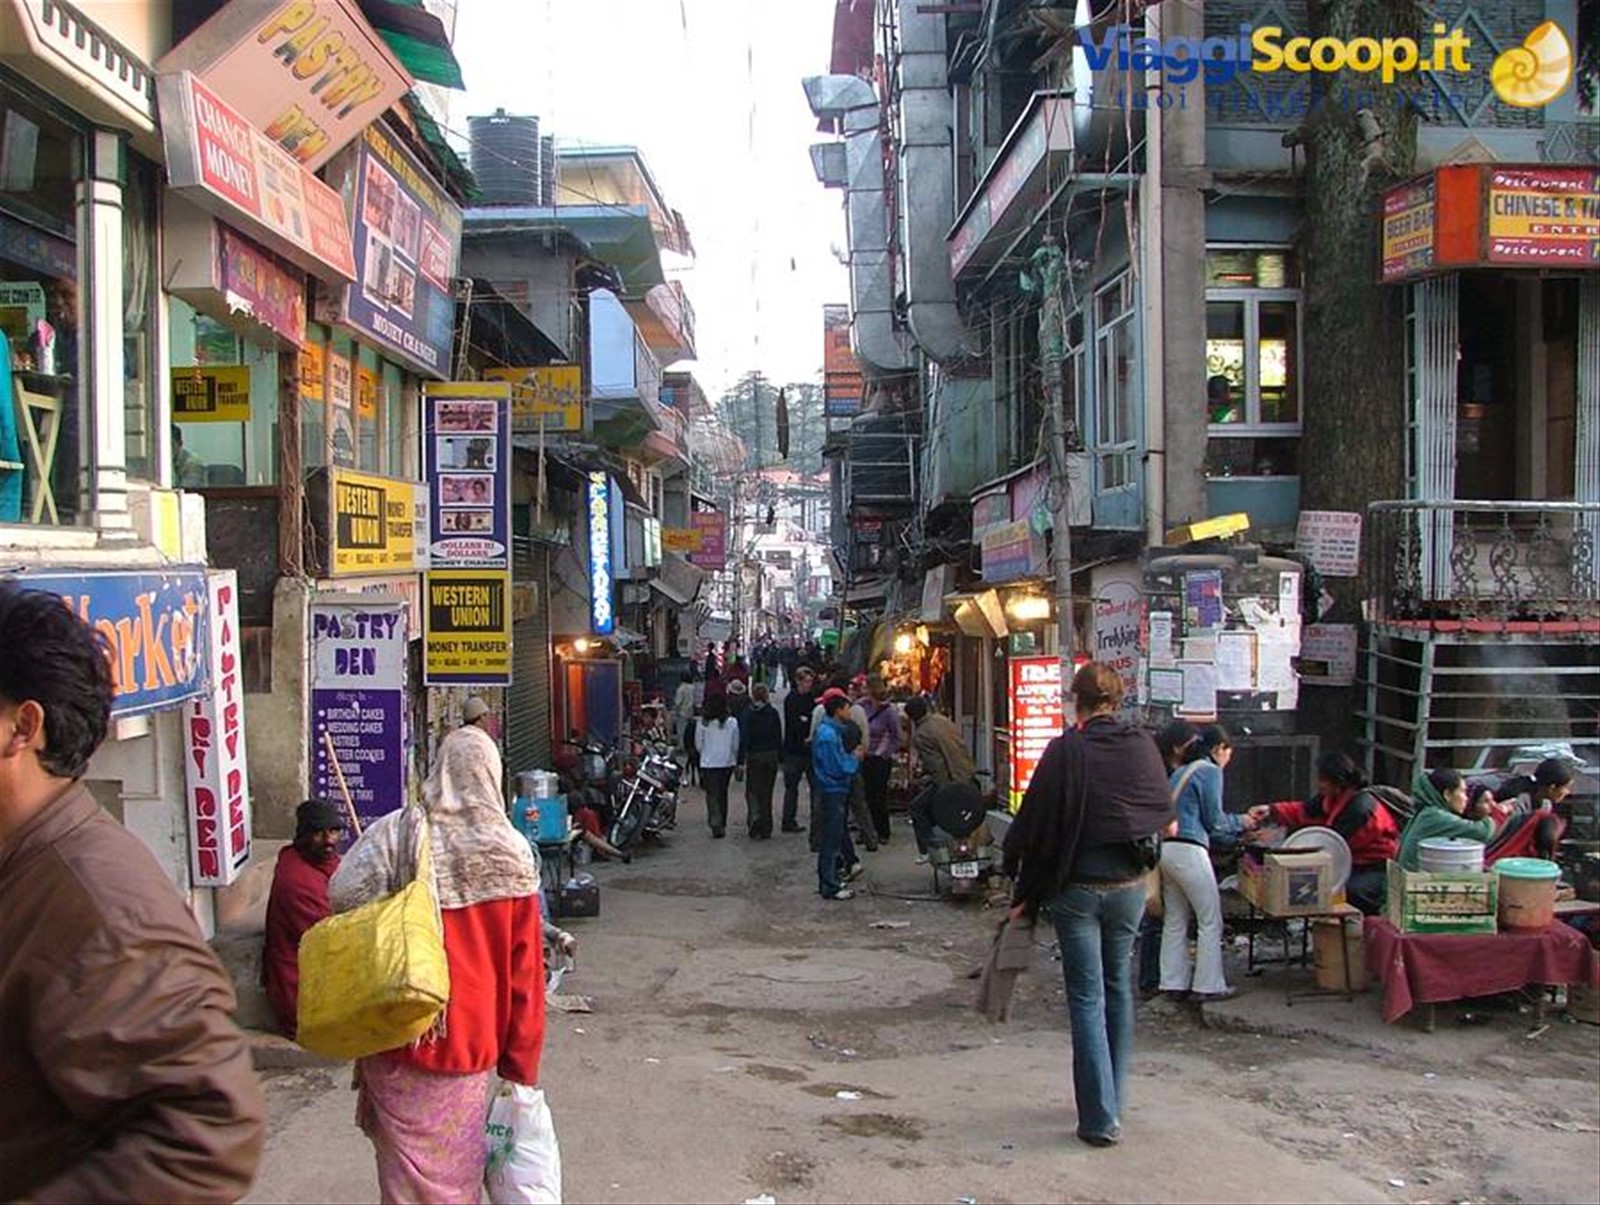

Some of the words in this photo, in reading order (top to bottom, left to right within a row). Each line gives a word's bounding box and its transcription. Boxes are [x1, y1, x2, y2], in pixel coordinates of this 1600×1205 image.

[257, 0, 385, 120] PASTRY
[195, 91, 250, 158] CHANGE
[205, 137, 254, 200] MONEY
[1494, 194, 1562, 217] CHINESE
[1564, 197, 1576, 218] &
[372, 311, 403, 346] MONEY
[403, 331, 438, 367] CHANGER
[440, 542, 482, 550] DOLLARS
[446, 550, 488, 558] DOLLARS
[432, 585, 490, 606] WESTERN
[313, 613, 400, 640] PASTRY
[452, 606, 490, 626] UNION
[62, 592, 199, 698] arket
[428, 641, 459, 653] MONEY
[461, 641, 507, 653] TRANSFER
[1097, 624, 1140, 652] Trekking
[335, 647, 376, 676] DEN
[361, 708, 385, 721] CAKES
[328, 722, 359, 734] WEDDING
[360, 722, 384, 734] CAKES
[329, 735, 360, 747] ASTRIES
